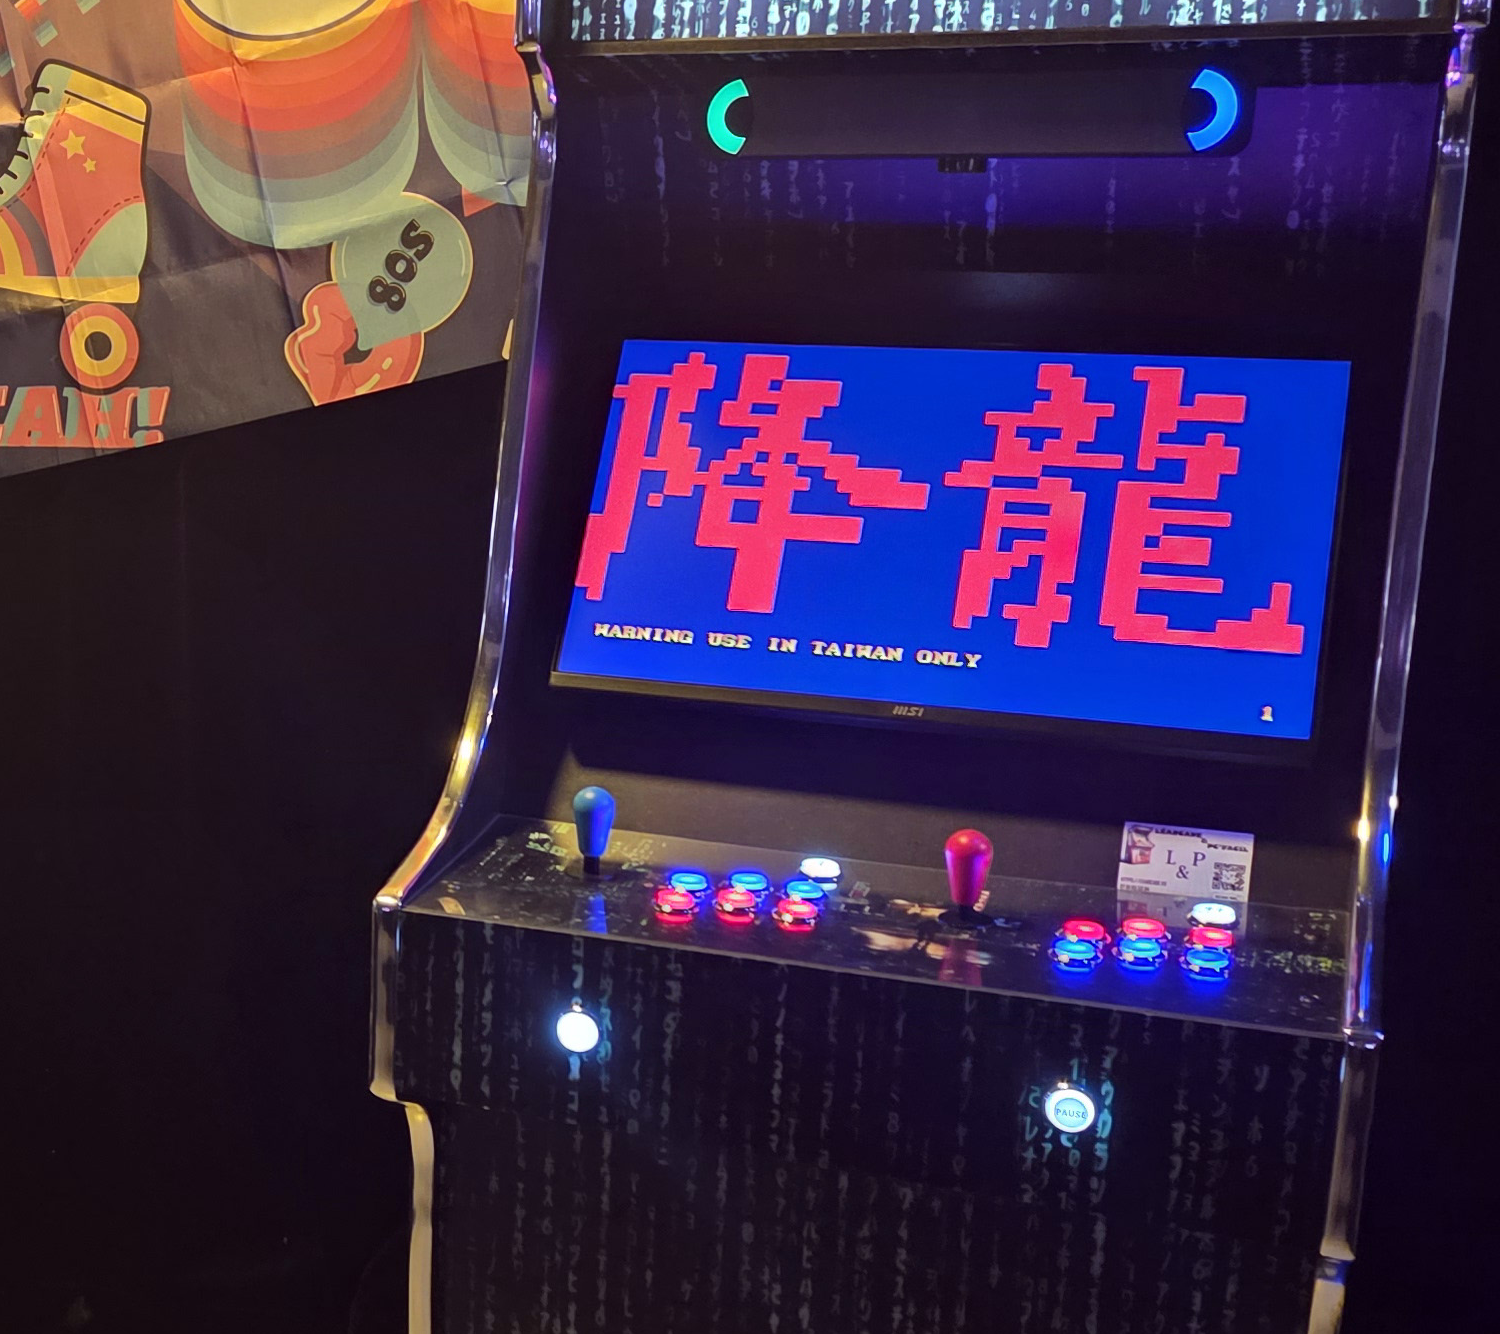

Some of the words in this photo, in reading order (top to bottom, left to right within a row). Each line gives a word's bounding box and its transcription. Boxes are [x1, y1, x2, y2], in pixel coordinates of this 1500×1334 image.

[575, 351, 1306, 656] 降龍
[594, 622, 694, 646] WARNING
[707, 631, 751, 651] USE
[767, 635, 797, 655] IN
[811, 640, 903, 663] TAIWAN
[916, 648, 982, 670] ONLY
[1261, 704, 1274, 723] 1
[1193, 851, 1206, 866] P
[1175, 864, 1189, 880] &
[1056, 1108, 1087, 1120] PAUSE
